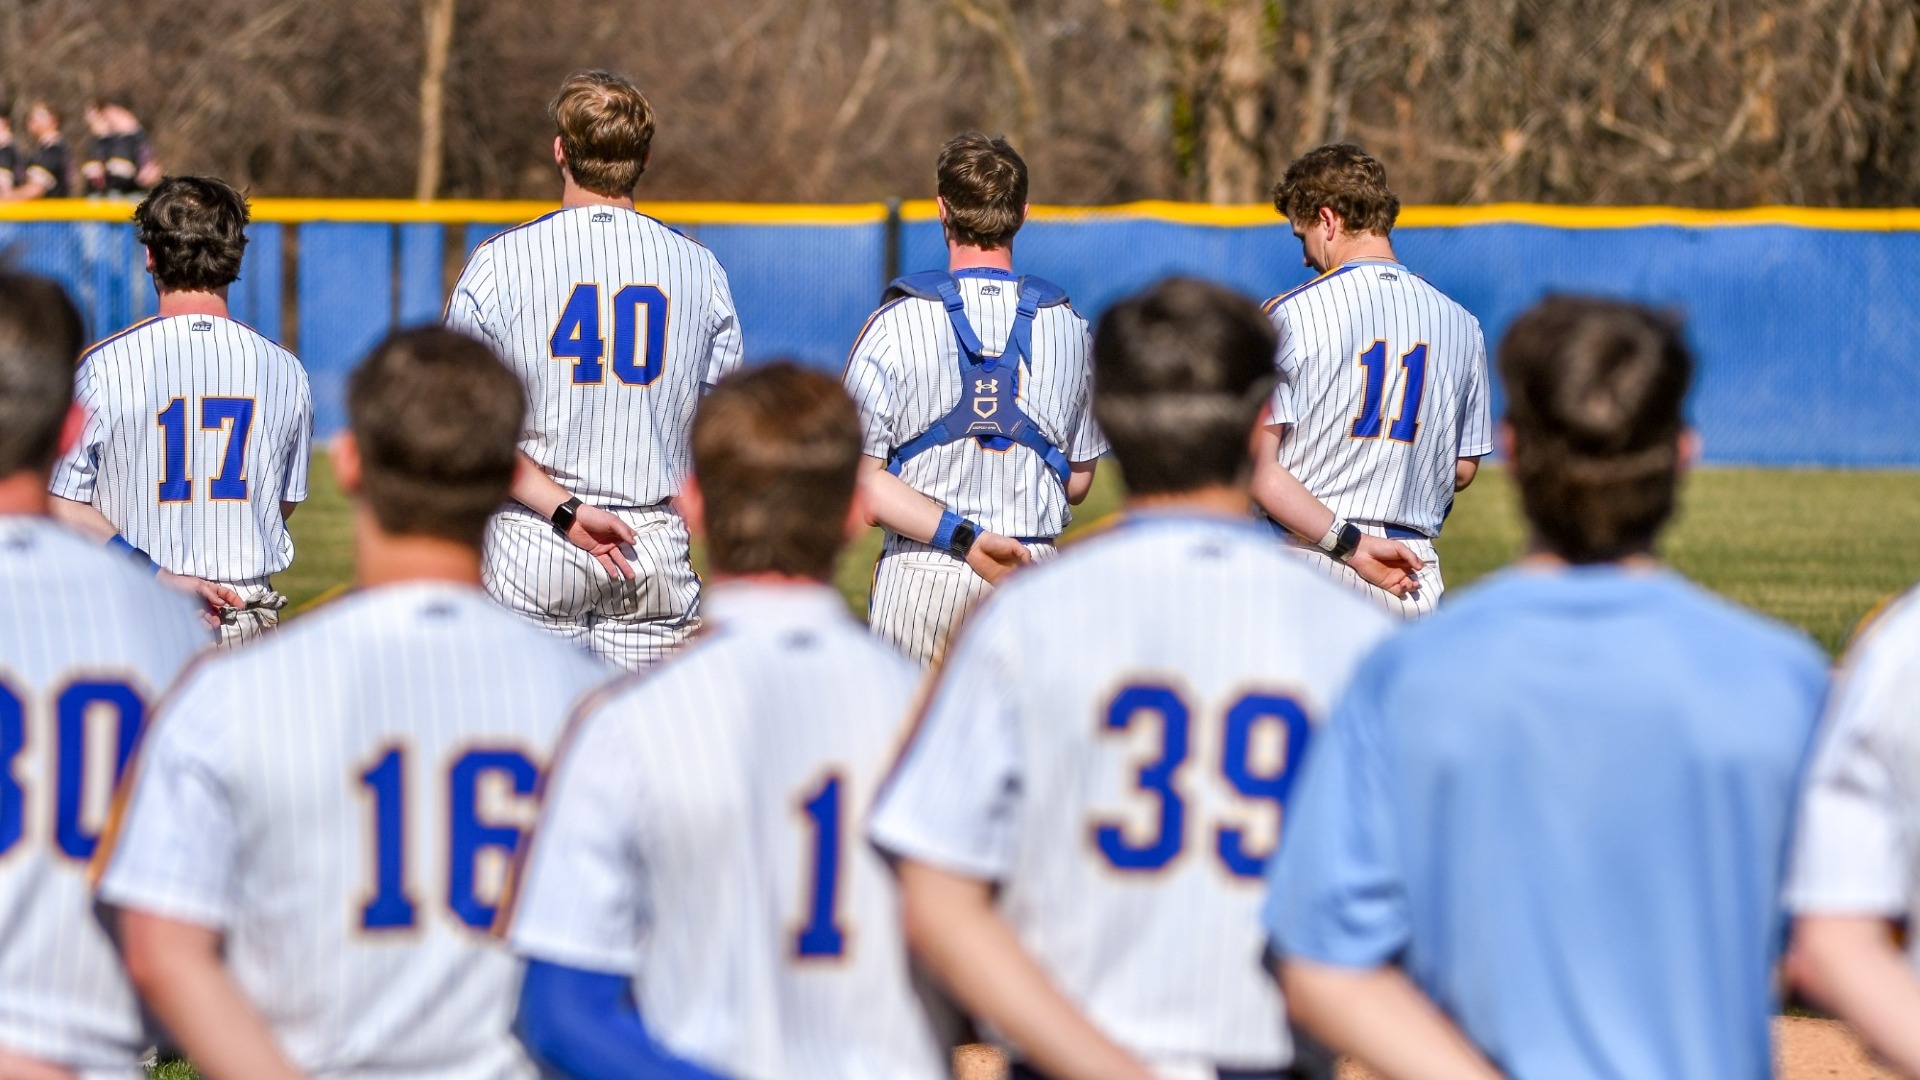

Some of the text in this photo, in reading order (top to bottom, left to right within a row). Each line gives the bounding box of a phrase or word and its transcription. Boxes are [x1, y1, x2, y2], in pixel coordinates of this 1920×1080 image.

[549, 283, 669, 386] 40
[991, 269, 1009, 277] PRO
[157, 396, 255, 503] 17
[1350, 340, 1429, 443] 11
[0, 675, 148, 865] 0
[357, 743, 539, 935] 16
[1092, 680, 1315, 880] 39
[792, 773, 846, 960] 1
